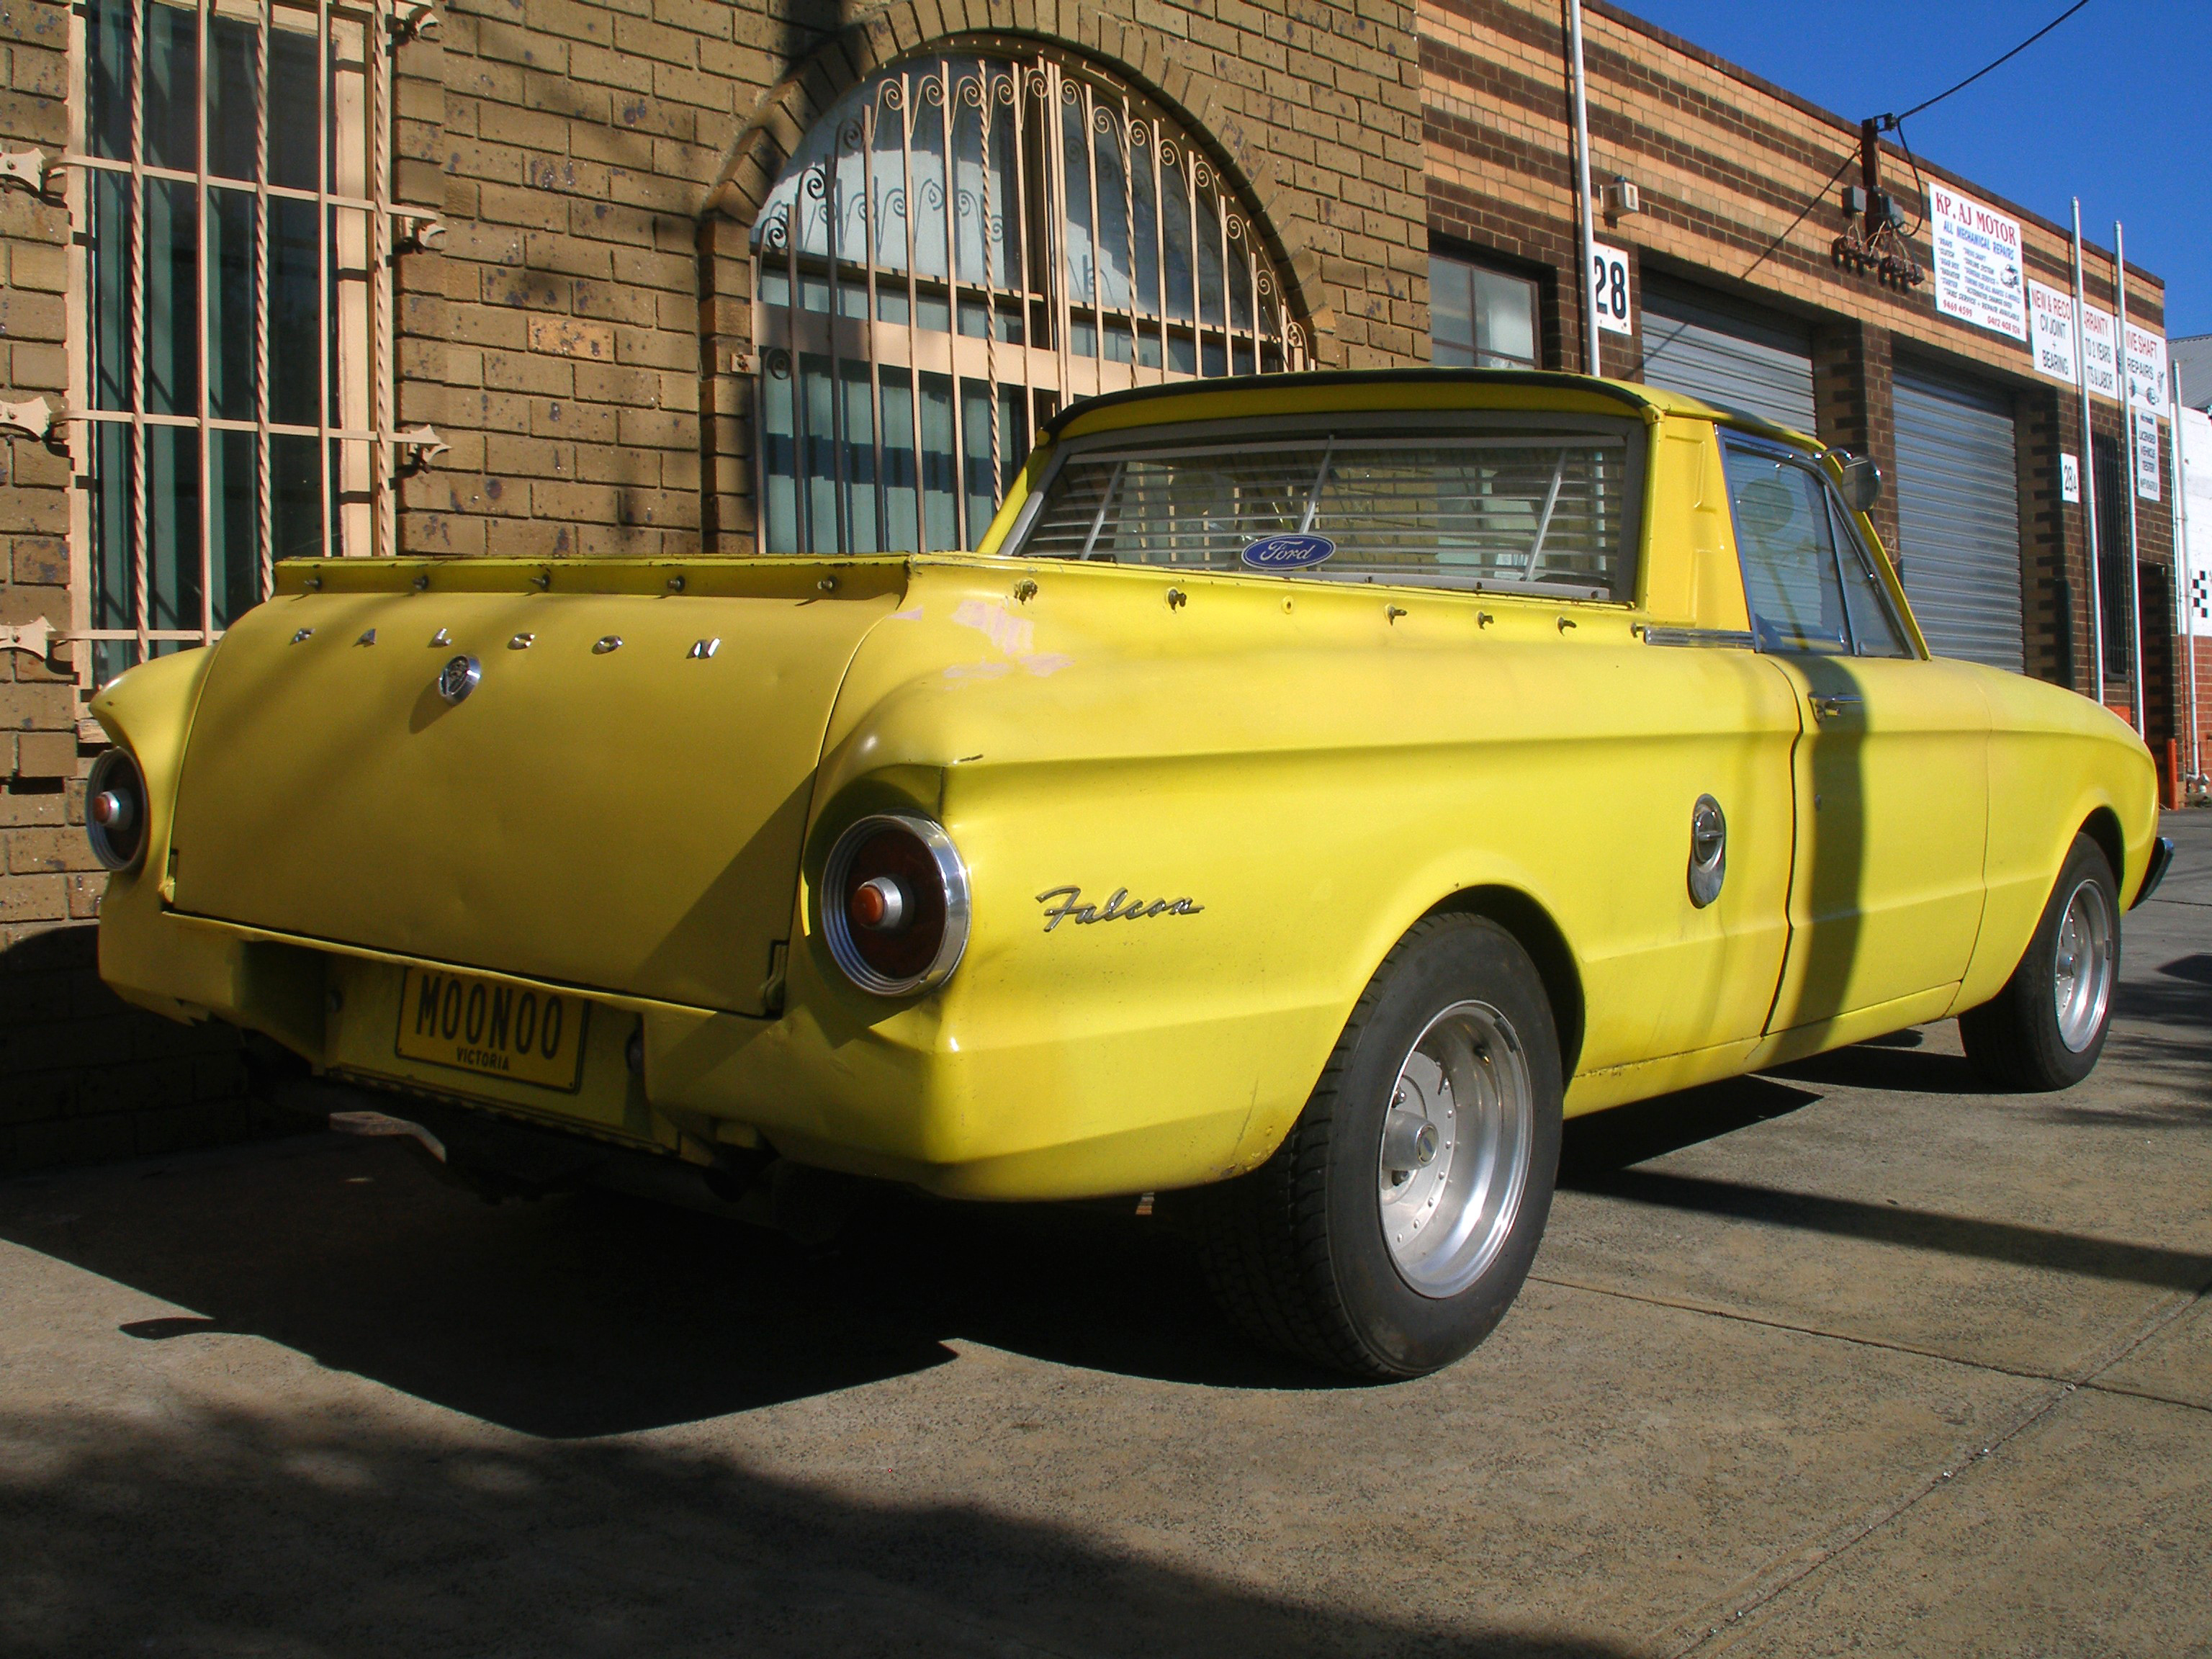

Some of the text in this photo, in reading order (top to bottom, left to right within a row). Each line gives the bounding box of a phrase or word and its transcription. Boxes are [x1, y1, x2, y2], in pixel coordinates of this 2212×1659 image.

[1943, 220, 2014, 261] ALL MECHANICAL REPAIRS
[1976, 211, 2016, 246] MOTOR
[1594, 255, 1627, 320] 28
[1959, 293, 1976, 305] SERVICE
[1943, 299, 1957, 312] 9469
[1959, 305, 1972, 317] 4599
[2031, 288, 2046, 310] NEW
[2053, 297, 2071, 320] RECO
[2049, 318, 2066, 339] JOINT
[2083, 310, 2108, 336] ARRANTY
[2097, 341, 2111, 364] YEARS
[2138, 334, 2157, 359] SHAFT
[2042, 349, 2069, 375] BEARING
[2127, 357, 2154, 380] REPAIRS
[2098, 369, 2113, 391] LABOR
[1259, 540, 1316, 561] Ford
[1035, 885, 1205, 932] Falcon
[457, 1046, 510, 1071] VICTORIA
